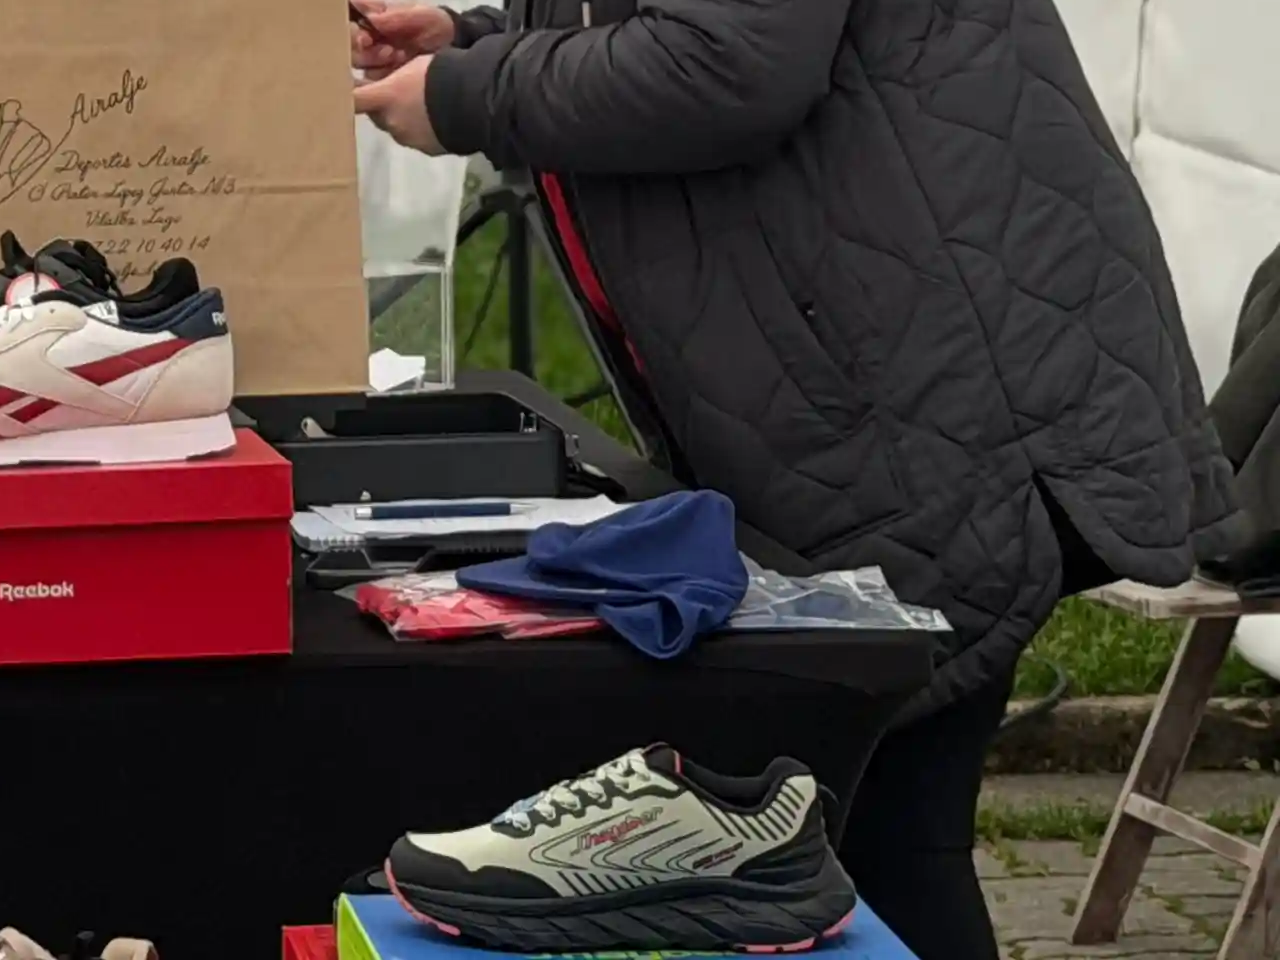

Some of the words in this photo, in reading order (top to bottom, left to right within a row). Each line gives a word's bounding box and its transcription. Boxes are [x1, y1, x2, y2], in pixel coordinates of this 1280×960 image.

[71, 69, 148, 124] Airalje
[55, 149, 131, 181] Deportes
[138, 145, 211, 175] Airalje
[136, 238, 156, 253] 10
[159, 237, 184, 252] 40
[189, 236, 211, 250] 14
